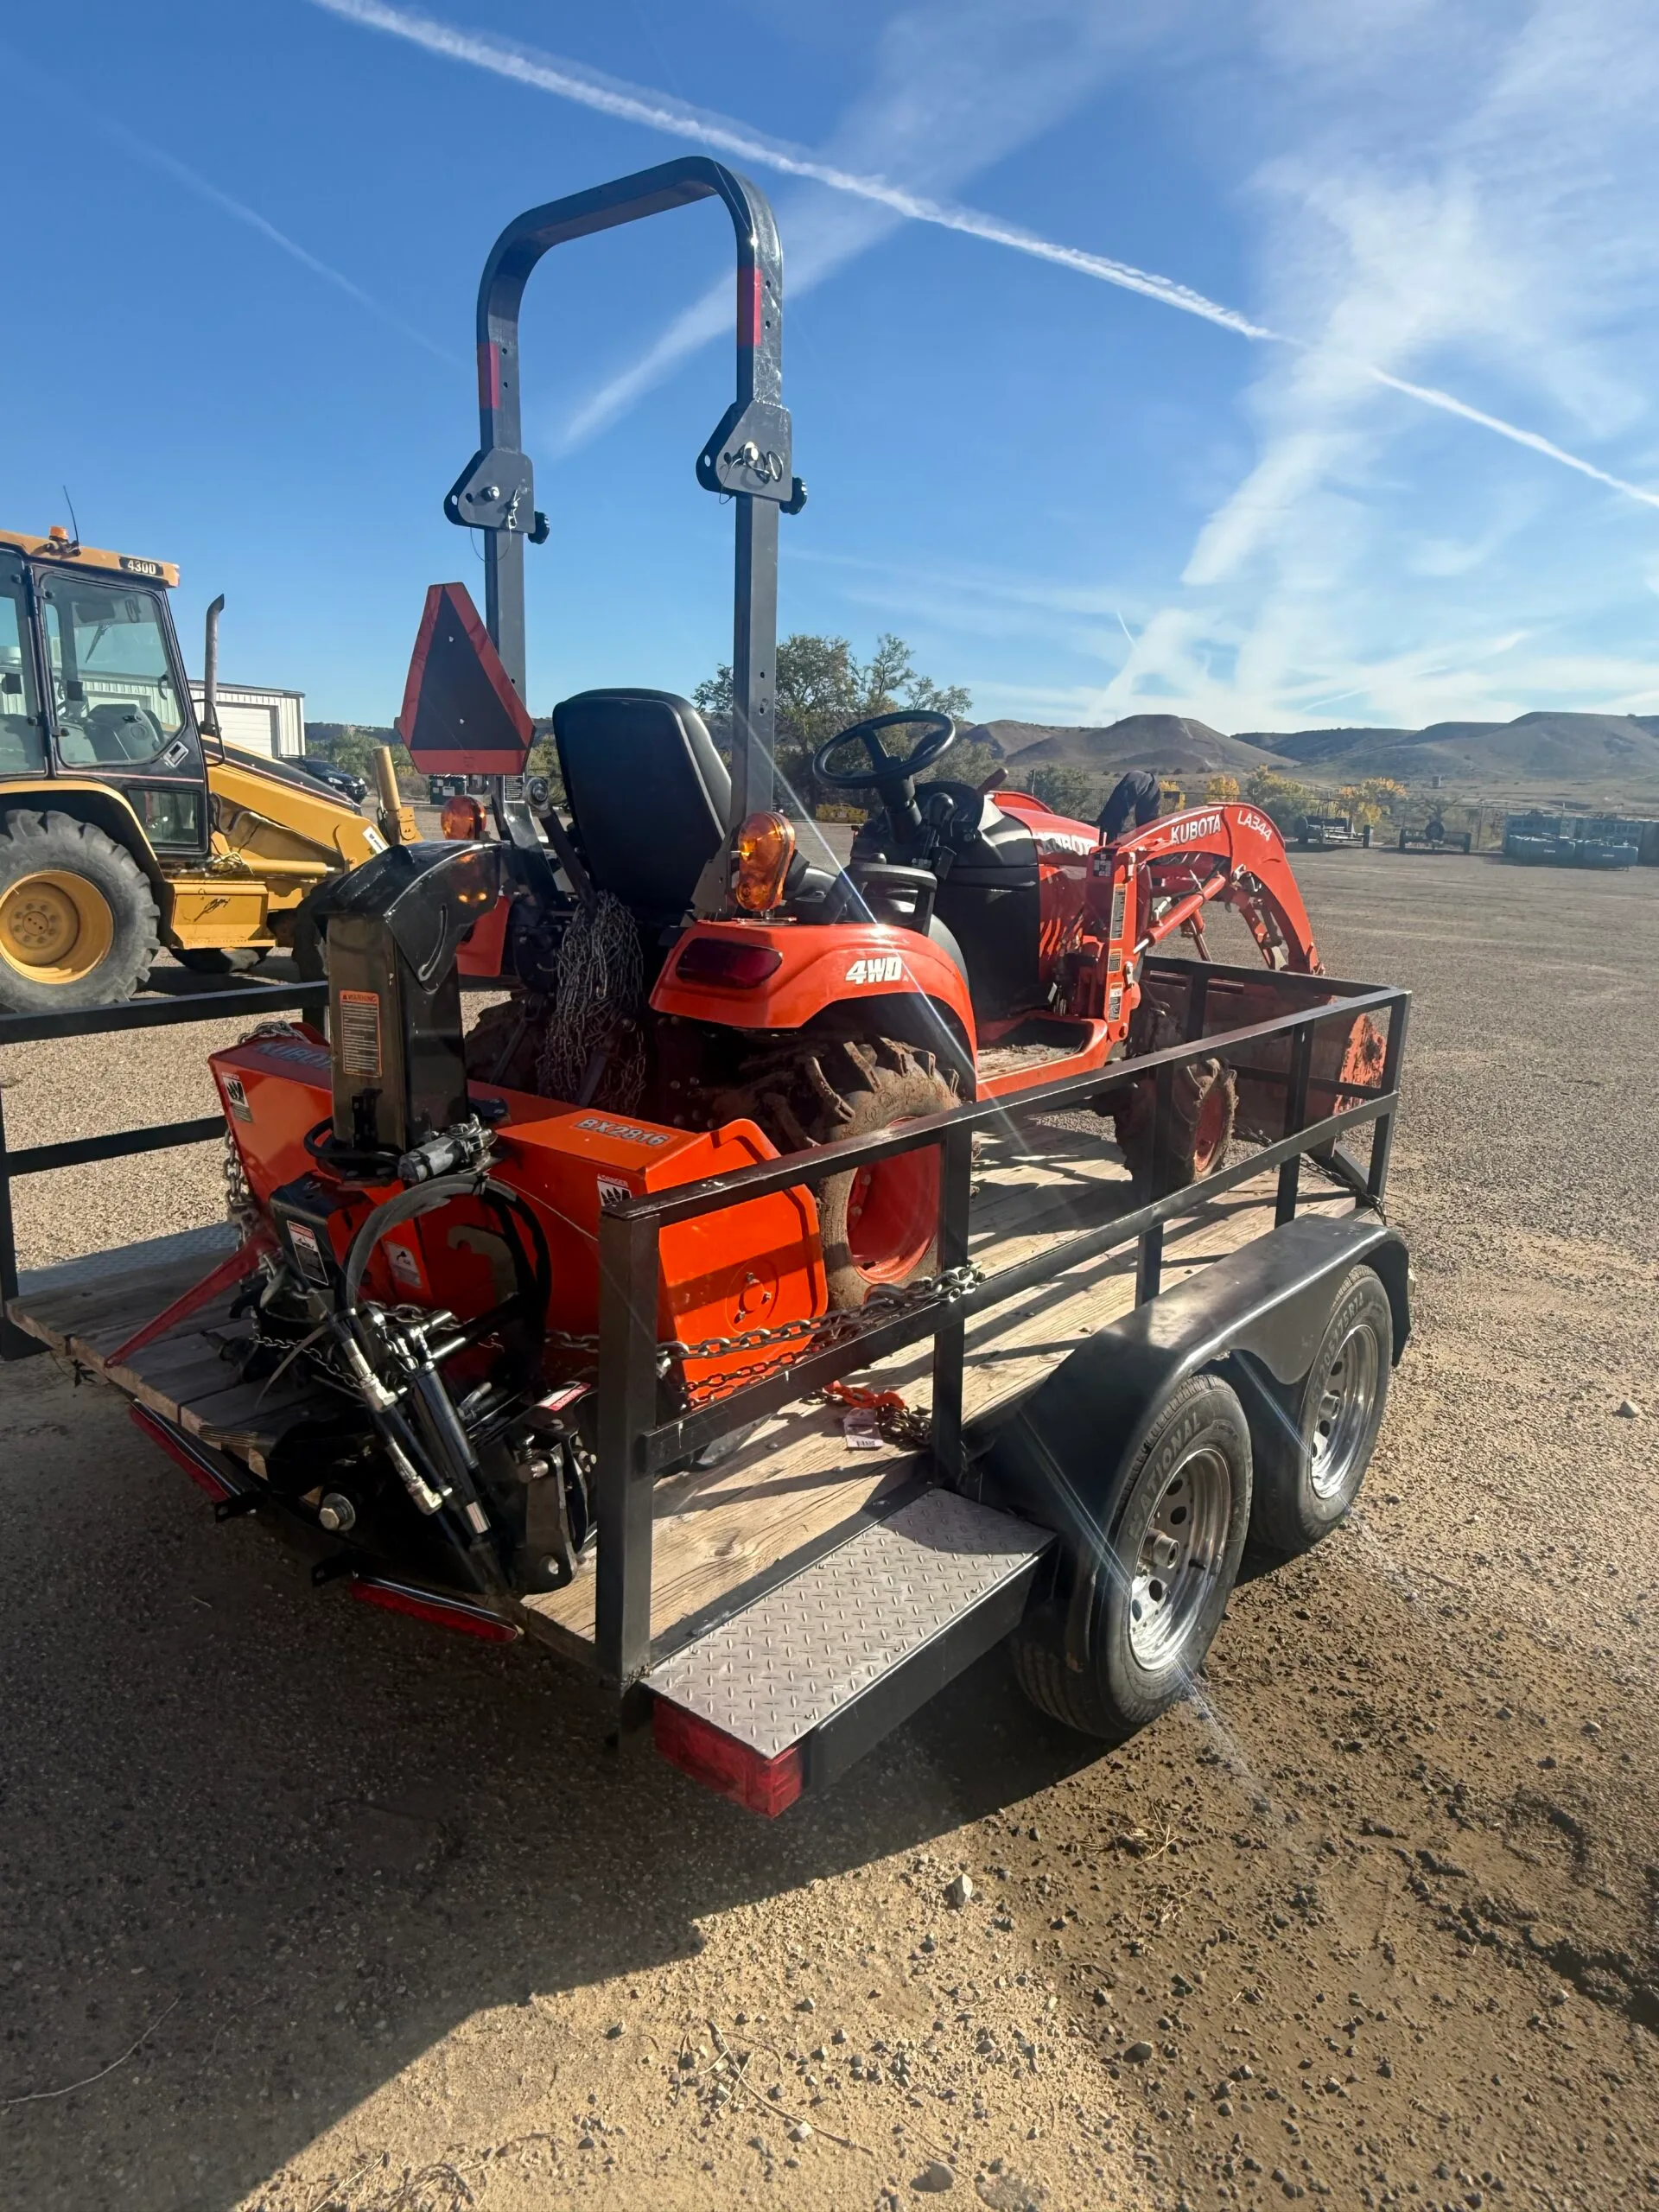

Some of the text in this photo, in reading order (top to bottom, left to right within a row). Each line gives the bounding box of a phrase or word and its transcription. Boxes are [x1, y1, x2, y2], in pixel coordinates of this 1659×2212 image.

[127, 559, 156, 575] 430D
[1170, 814, 1221, 844] KUBOTA
[1237, 810, 1272, 842] LA344
[845, 957, 902, 985] 4WD
[575, 1118, 671, 1146] BX2816
